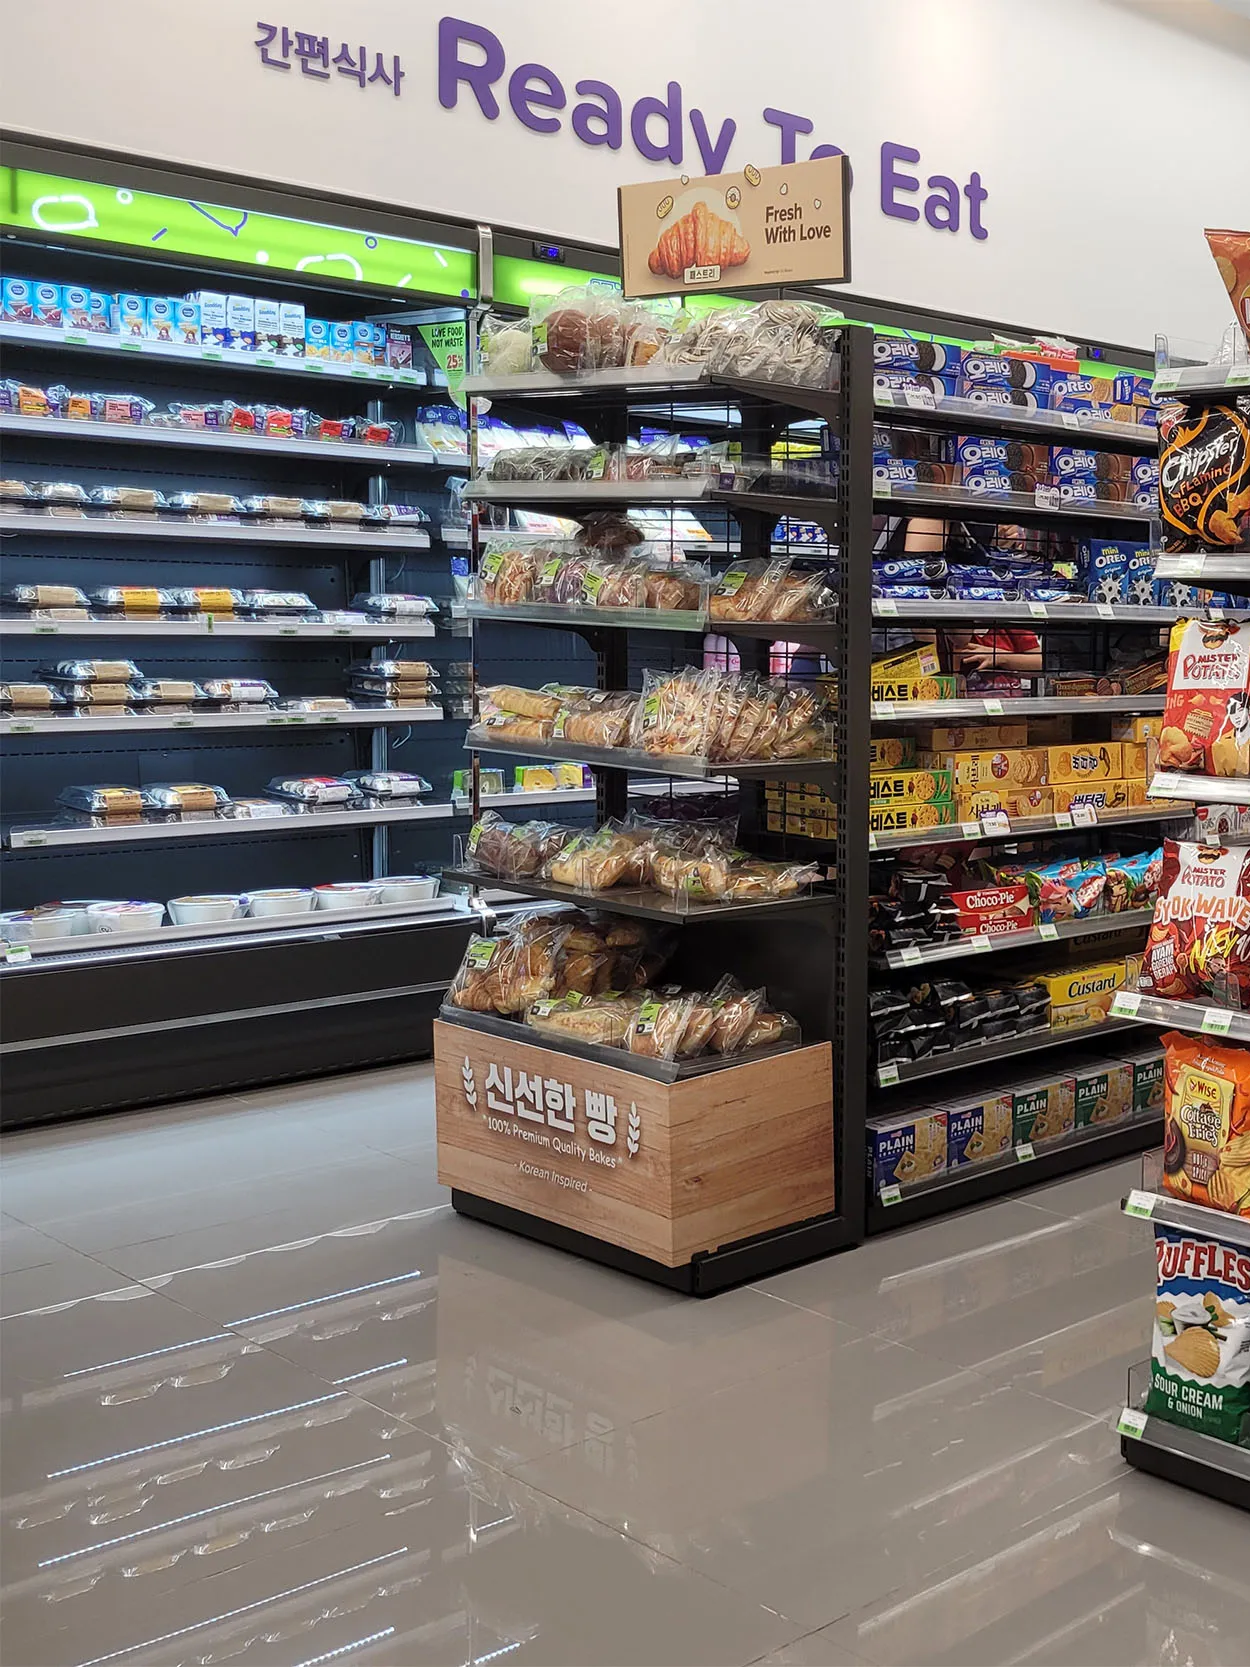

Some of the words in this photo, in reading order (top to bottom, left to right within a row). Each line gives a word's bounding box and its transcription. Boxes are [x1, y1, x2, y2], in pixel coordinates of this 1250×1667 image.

[254, 20, 405, 97] 간편식사
[438, 16, 737, 175] Ready
[880, 141, 989, 240] Eat
[765, 203, 803, 224] Fresh
[764, 225, 796, 245] With
[800, 222, 832, 241] Love
[689, 268, 716, 280] 패스트리
[431, 327, 446, 337] LOVE
[431, 339, 443, 348] NOT
[445, 337, 463, 347] WASTE
[873, 341, 920, 366] 오레오
[966, 359, 1012, 381] 오레오
[1053, 381, 1093, 396] OREO
[963, 445, 1008, 467] 오레오
[1058, 456, 1097, 475] 오레오
[1162, 433, 1238, 488] Chipster
[968, 476, 1012, 494] 오레오
[1172, 492, 1204, 518] BBQ
[1101, 546, 1119, 555] mini
[1095, 553, 1127, 568] OREO
[1198, 653, 1238, 663] MISTER
[871, 812, 908, 831] 비스트
[1192, 867, 1227, 875] MISTER
[966, 891, 1015, 909] Choco-Pie
[1153, 895, 1192, 925] SYOK
[980, 919, 1018, 935] Choco-Pie
[1151, 943, 1174, 961] AYAM
[1068, 975, 1116, 998] Custard
[1137, 1067, 1163, 1083] PLAIN
[1078, 1082, 1108, 1098] PLAIN
[484, 1062, 577, 1133] 신선한
[586, 1088, 617, 1146] 빵
[1016, 1098, 1047, 1115] PLAIN
[950, 1115, 983, 1133] PLAIN
[1180, 1104, 1222, 1132] Cottage
[512, 1124, 551, 1148] Premium
[552, 1138, 587, 1163] Quality
[878, 1134, 914, 1152] PLAIN
[1188, 1122, 1219, 1148] Fries
[518, 1160, 550, 1181] Korean
[551, 1170, 588, 1194] Inspired
[1154, 1374, 1179, 1396] SOUR
[1181, 1387, 1224, 1411] CREAM
[1167, 1397, 1174, 1409] &
[1176, 1400, 1203, 1419] ONION
